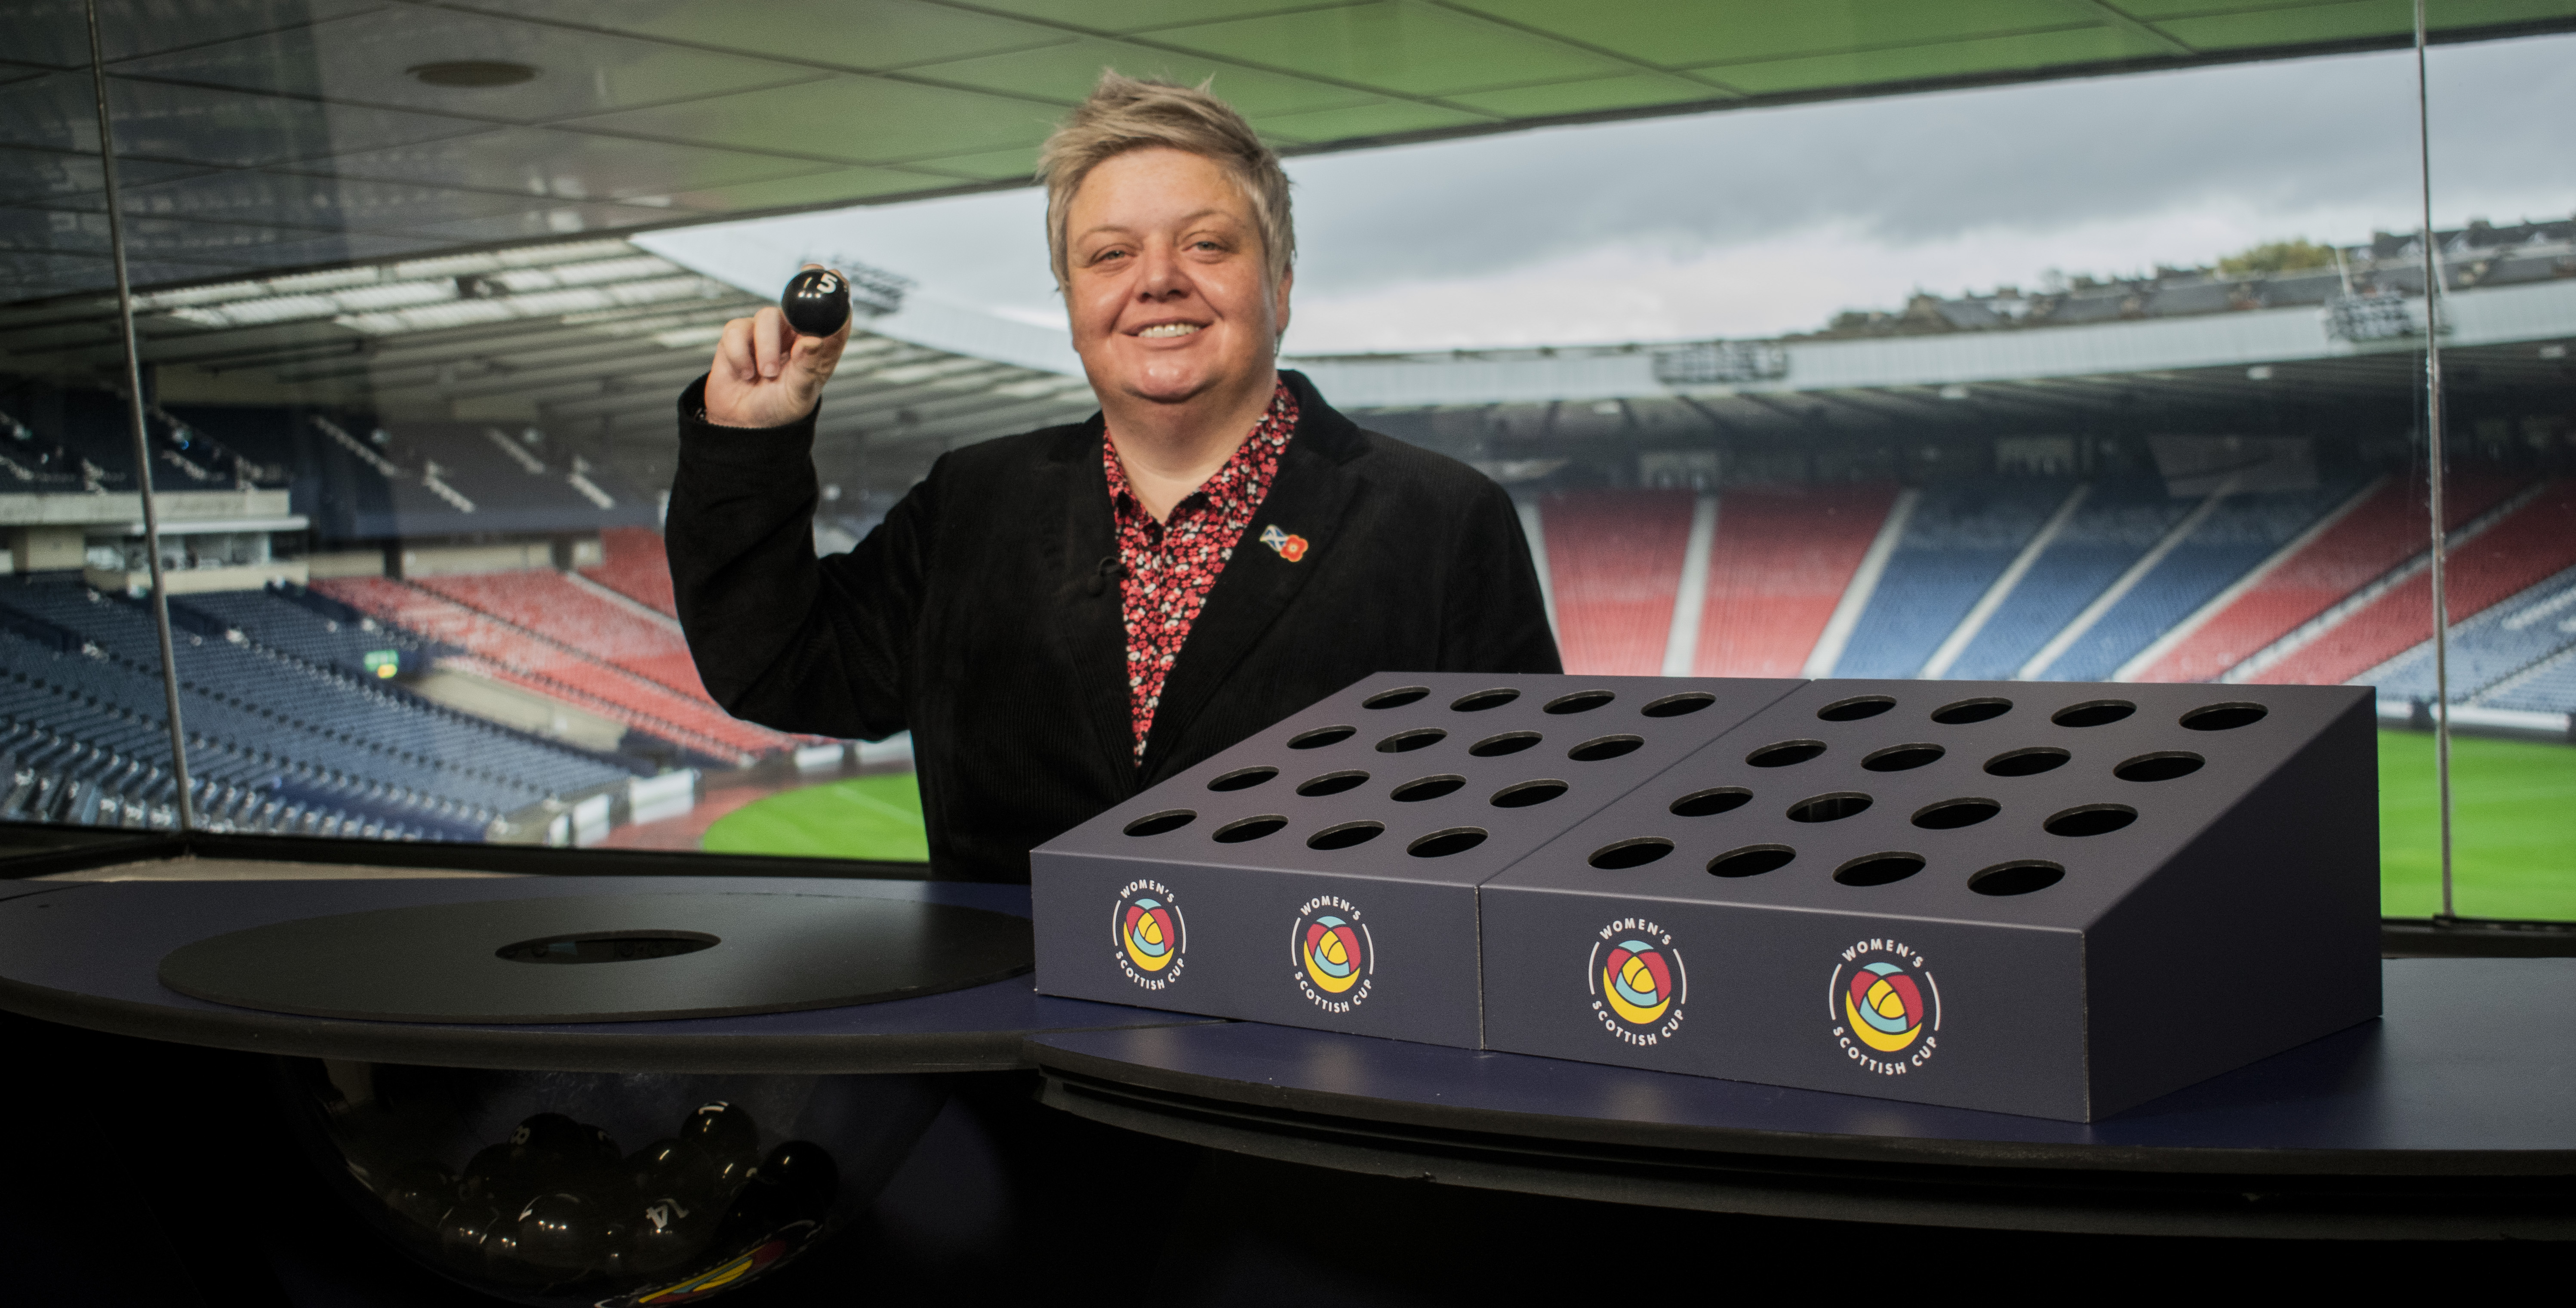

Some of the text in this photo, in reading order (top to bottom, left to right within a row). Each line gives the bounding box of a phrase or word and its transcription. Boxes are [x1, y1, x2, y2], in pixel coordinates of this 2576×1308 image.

[1120, 879, 1175, 903] WOMEN'S
[1300, 895, 1361, 921] WOMEN'S
[1599, 917, 1671, 945] WOMEN'S
[1115, 950, 1185, 990] SCOTTISH CUP
[1841, 938, 1924, 968] WOMEN'S
[1294, 971, 1372, 1013] SCOTTISH CUP
[1592, 1000, 1683, 1046] SCOTTISH CUP
[1833, 1026, 1936, 1075] SCOTTISH CUP
